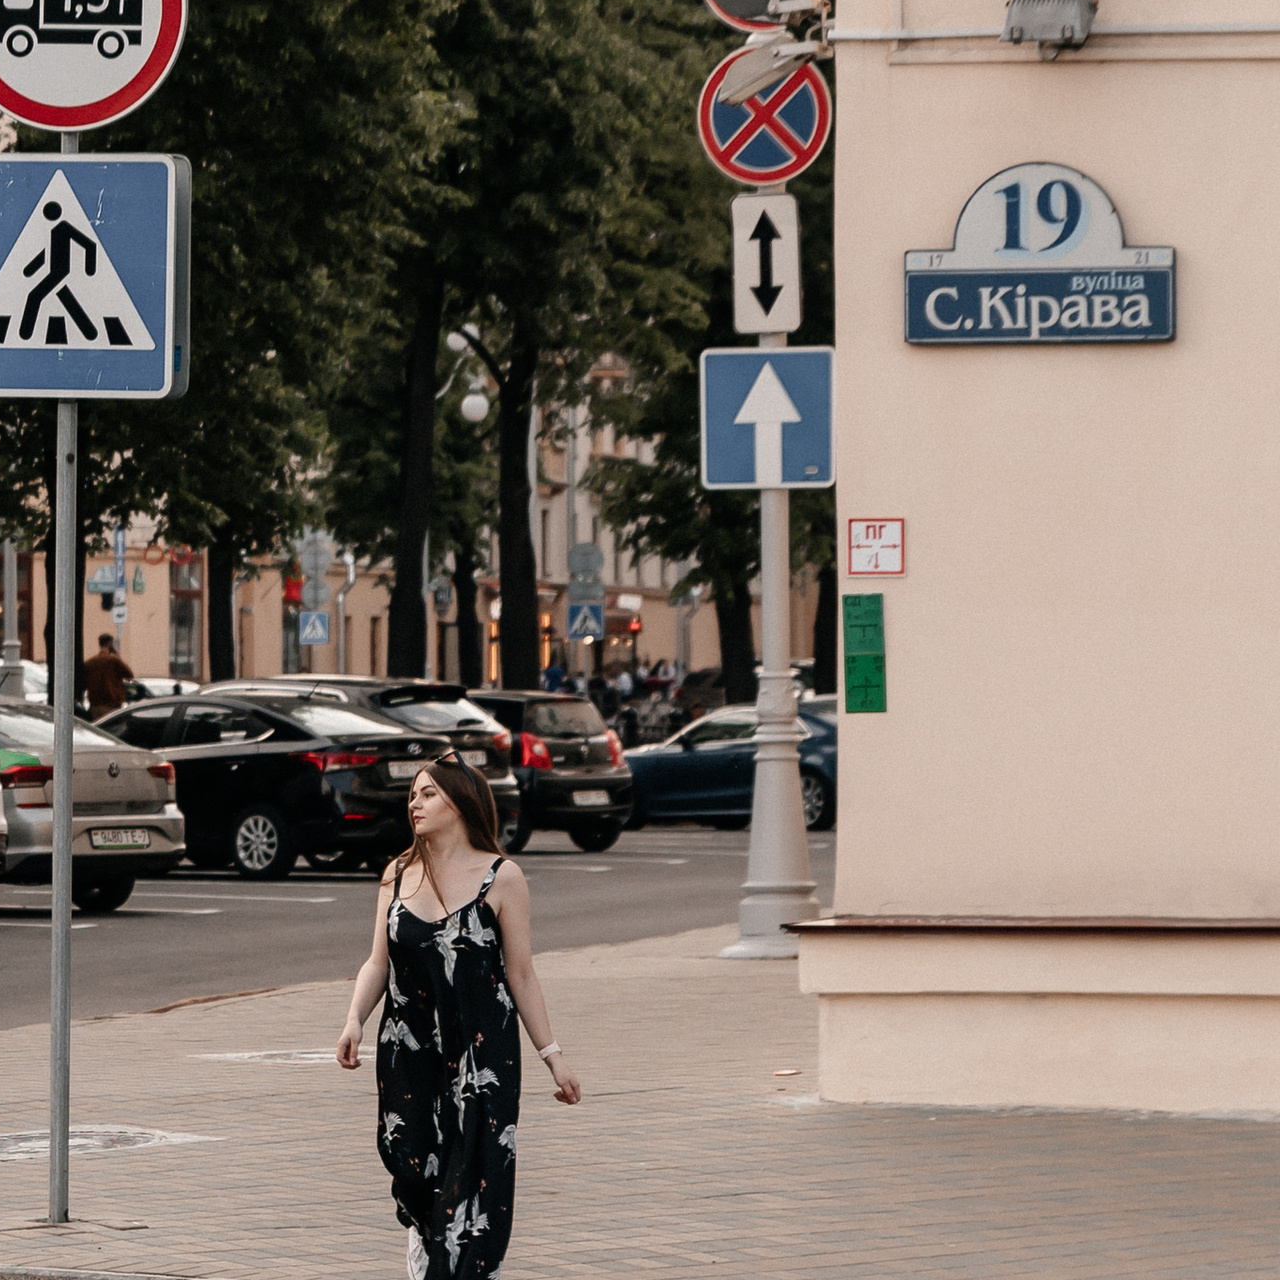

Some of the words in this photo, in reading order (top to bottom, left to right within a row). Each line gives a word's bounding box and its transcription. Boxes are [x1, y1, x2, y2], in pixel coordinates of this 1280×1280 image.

[994, 179, 1084, 255] 19
[927, 254, 944, 268] 17
[1134, 251, 1150, 265] 21
[1072, 270, 1145, 295] вуліца
[925, 283, 1152, 339] С.Кірава
[865, 525, 887, 540] ПГ
